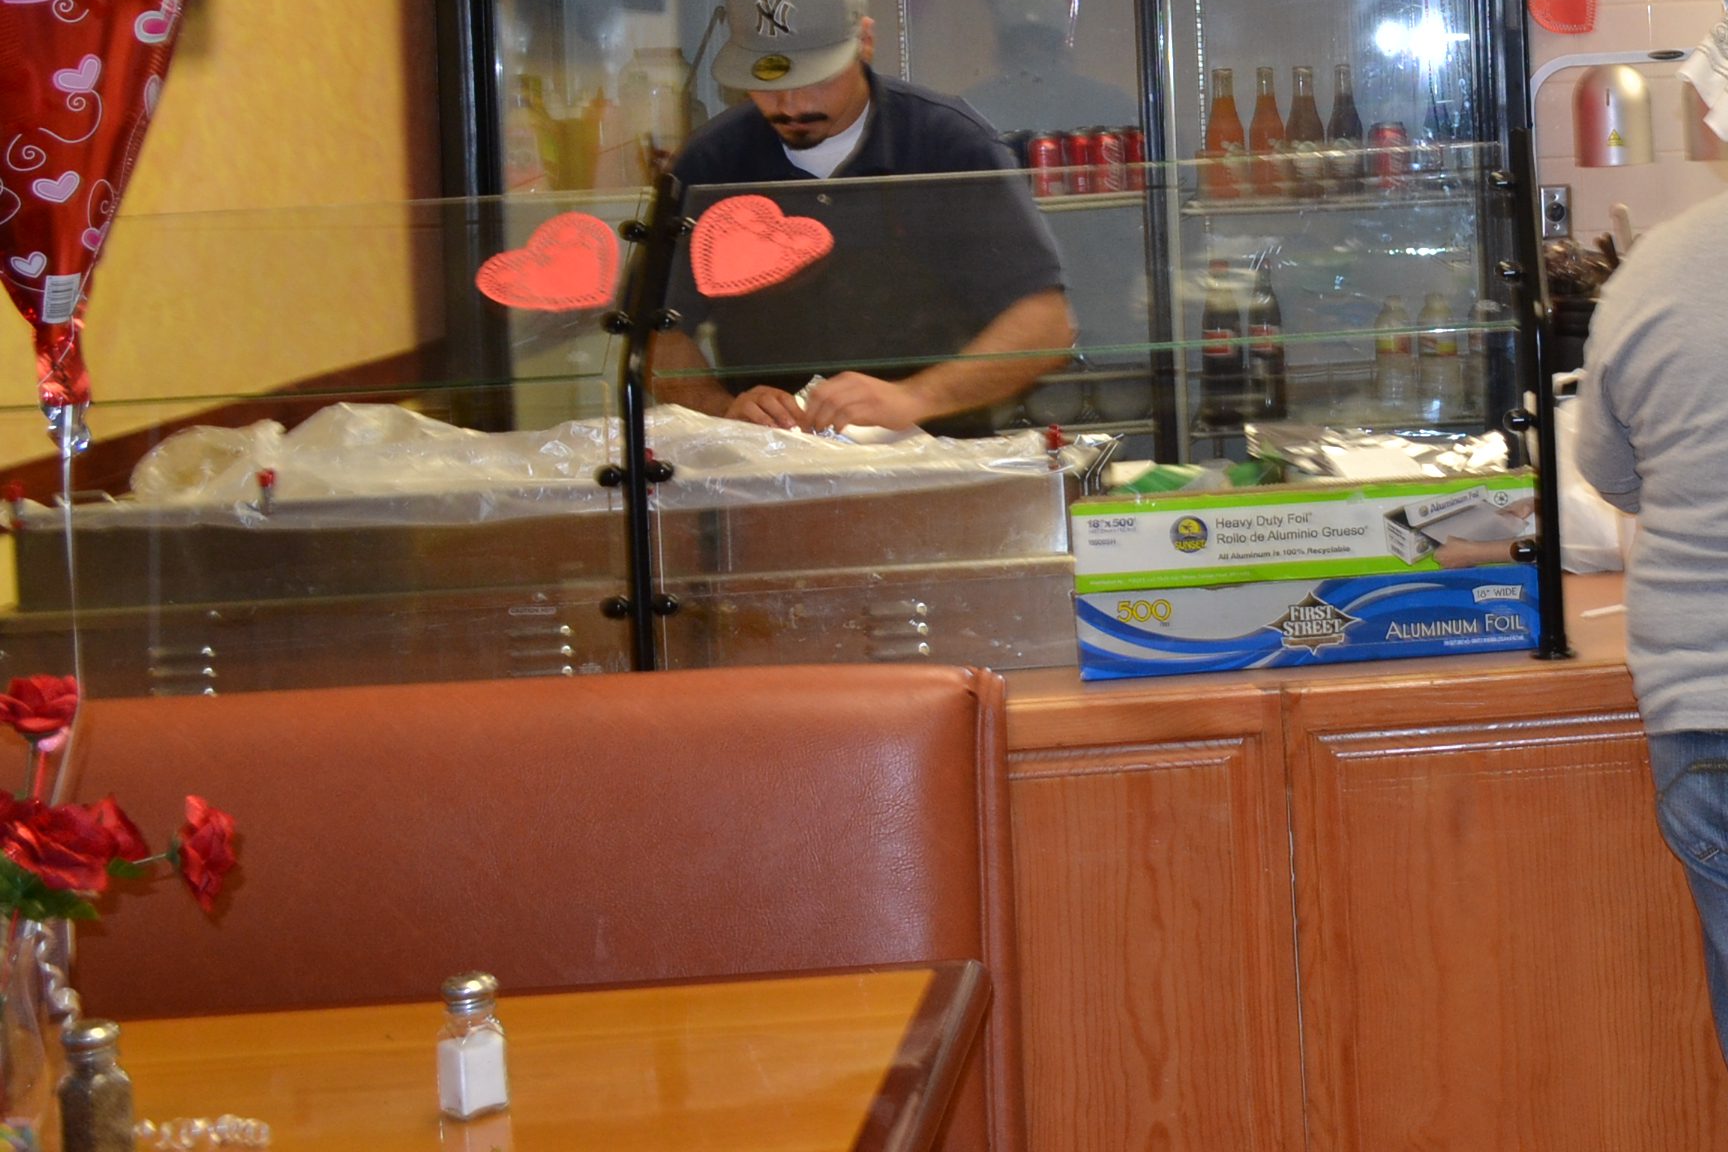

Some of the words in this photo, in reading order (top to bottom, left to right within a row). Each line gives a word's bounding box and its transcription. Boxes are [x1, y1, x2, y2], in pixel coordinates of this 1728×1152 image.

[1215, 517, 1252, 530] Heavy
[1256, 515, 1283, 528] Duty
[1216, 533, 1247, 544] Rollo
[1250, 532, 1264, 542] de
[1268, 529, 1318, 541] Aluminio
[1322, 527, 1365, 538] Grueso
[1218, 553, 1229, 561] All
[1231, 551, 1271, 560] Aluminum
[1307, 546, 1351, 556] Recyclable
[1493, 587, 1518, 597] WIDE
[1117, 599, 1172, 623] 500
[1290, 604, 1335, 621] FIRST
[1282, 619, 1343, 637] STREET
[1385, 618, 1478, 640] ALUMINUM
[1485, 614, 1525, 632] FOIL
